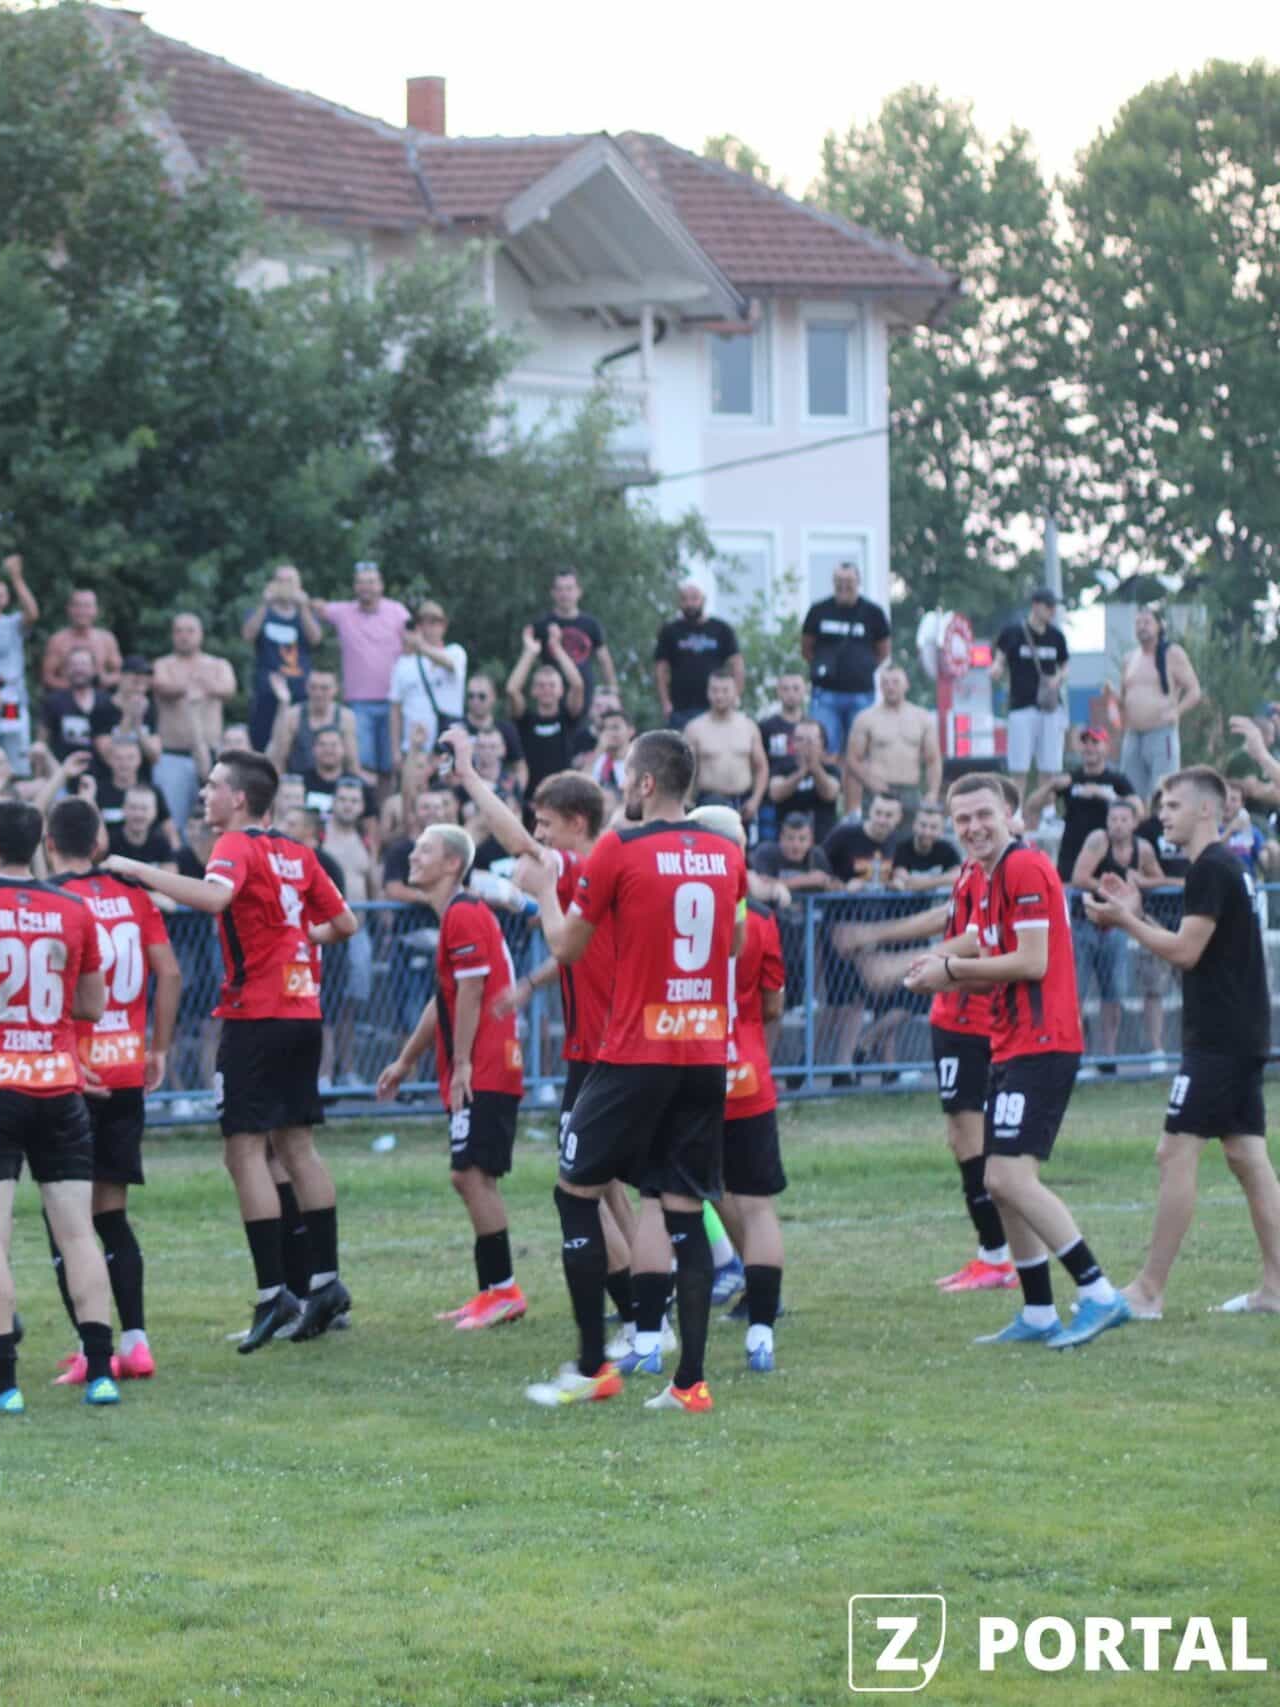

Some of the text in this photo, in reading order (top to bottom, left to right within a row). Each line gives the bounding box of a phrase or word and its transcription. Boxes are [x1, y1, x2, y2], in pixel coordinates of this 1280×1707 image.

[656, 849, 727, 876] NK ČELIK
[18, 908, 63, 933] ČELIK
[673, 882, 715, 972] 9
[939, 1057, 959, 1088] 17
